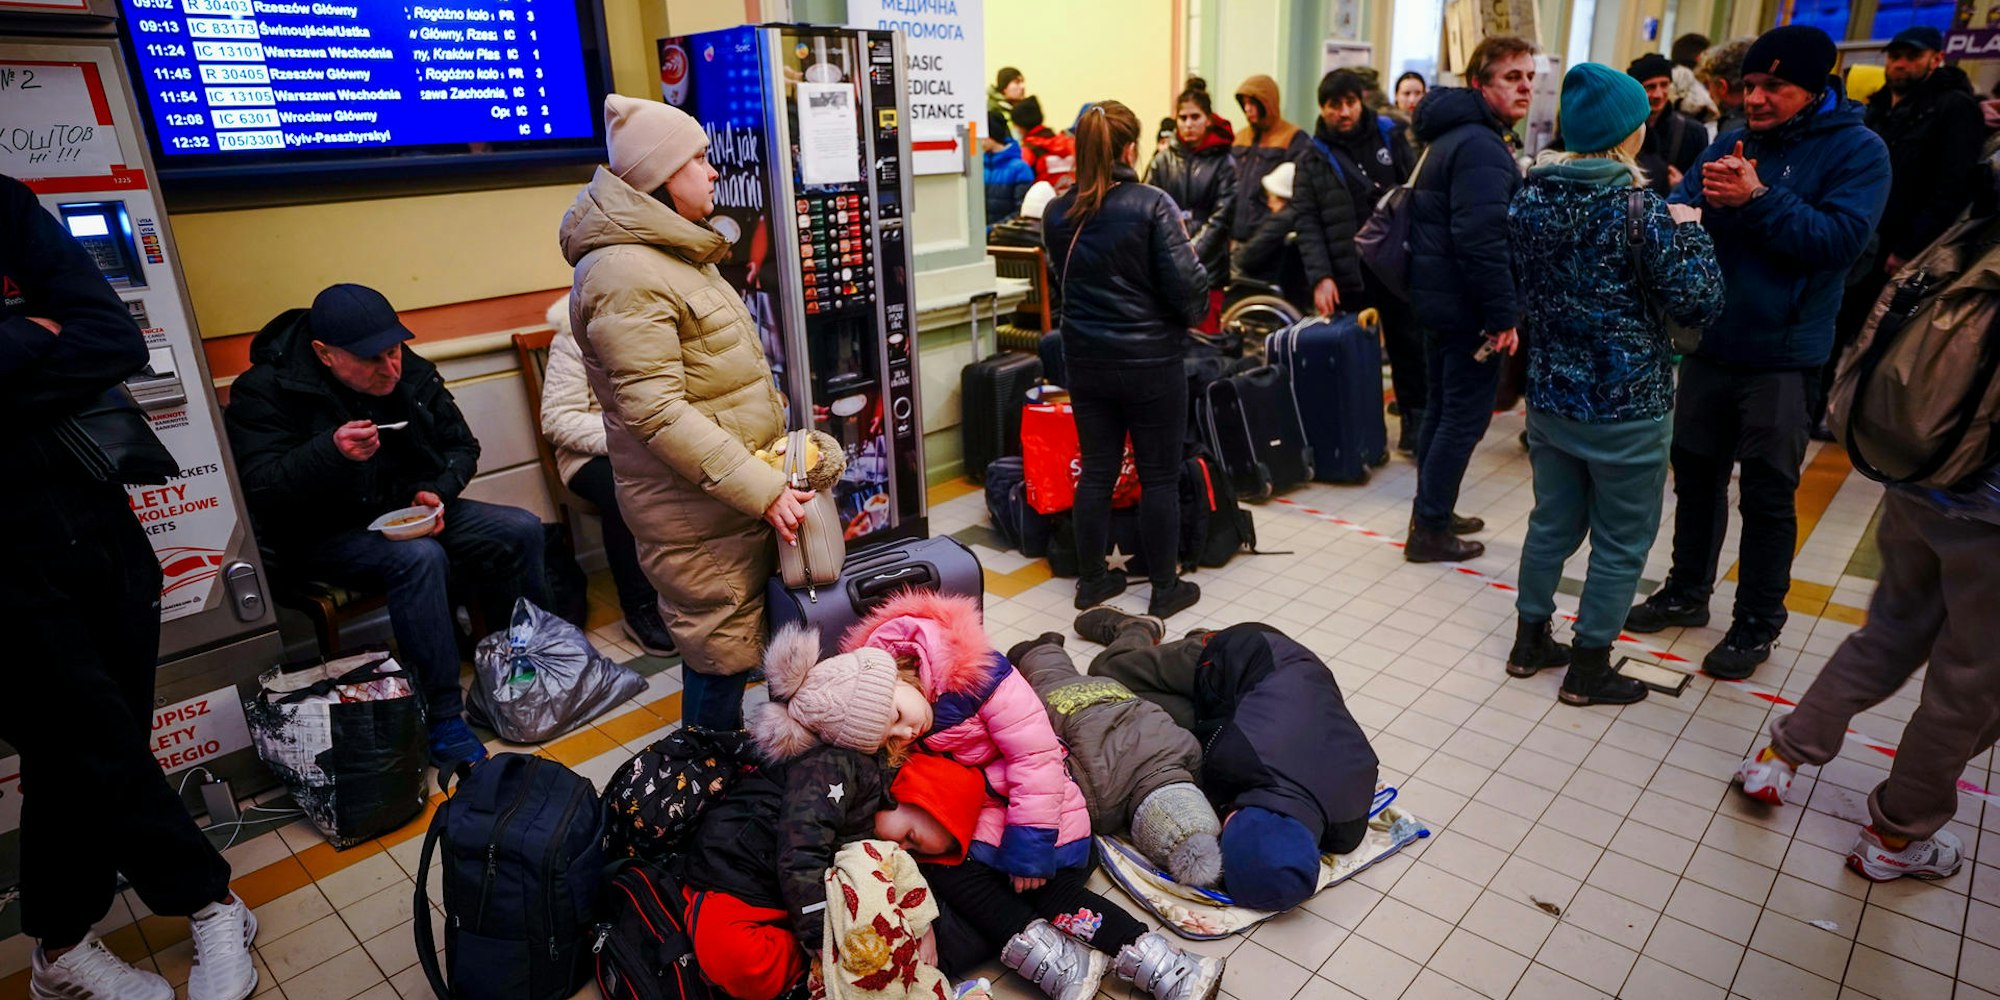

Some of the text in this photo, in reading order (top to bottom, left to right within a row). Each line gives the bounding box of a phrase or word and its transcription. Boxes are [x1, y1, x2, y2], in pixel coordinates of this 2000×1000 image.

[188, 0, 199, 9] R
[205, 0, 248, 11] 30403
[140, 20, 180, 33] 09:13
[191, 22, 207, 34] IC
[212, 23, 256, 35] 83173
[504, 29, 516, 40] IC
[530, 30, 537, 41] 1
[147, 44, 394, 59] 11:24 IC 13101 Warszawa Wschodnia
[507, 49, 519, 60] IC
[533, 49, 540, 60] 1
[20, 70, 42, 90] 2
[154, 67, 192, 80] 11:45
[206, 69, 217, 80] R
[222, 69, 265, 80] 30405
[269, 68, 325, 80] Rzeszów
[160, 89, 402, 103] 11:54 IC 13105 Warszawa Wschodnia
[513, 86, 525, 98] IC
[538, 86, 546, 97] 1
[516, 105, 528, 116] IC
[911, 104, 964, 119] STANCE
[166, 114, 204, 126] 12:08
[219, 114, 234, 125] IC
[239, 114, 272, 124] 6301
[172, 137, 210, 149] 12:32
[219, 135, 281, 147] 705/3301
[706, 121, 736, 165] AWA
[713, 166, 763, 211] wiarni
[170, 463, 218, 481] CKETS
[129, 484, 186, 511] LETY
[138, 497, 219, 523] KOLEJOWE
[144, 521, 176, 536] KETS
[151, 700, 211, 730] UPISZ
[157, 740, 220, 769] REGIO
